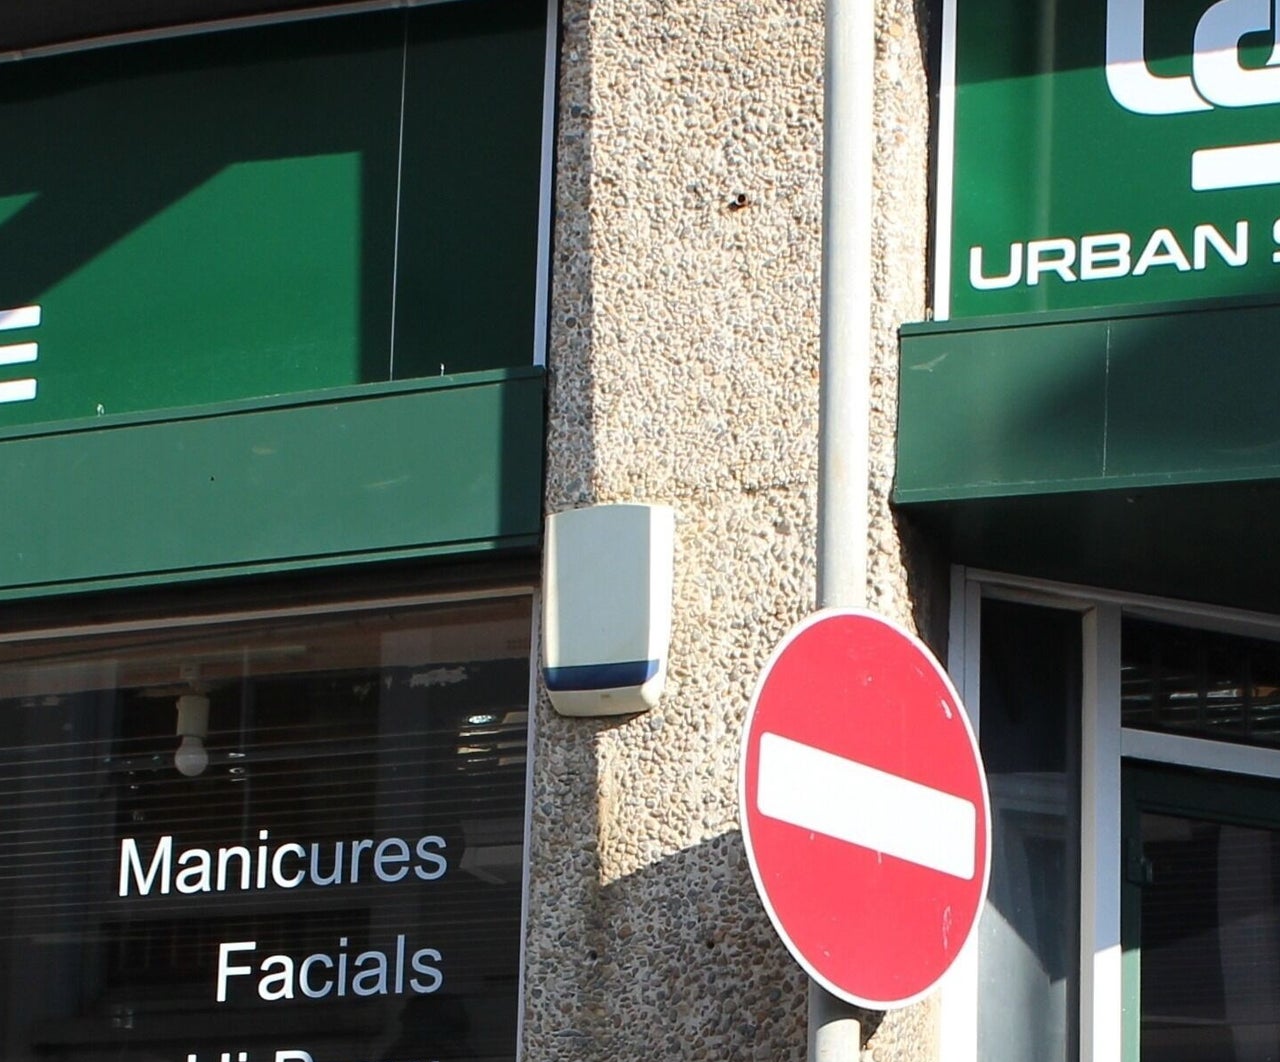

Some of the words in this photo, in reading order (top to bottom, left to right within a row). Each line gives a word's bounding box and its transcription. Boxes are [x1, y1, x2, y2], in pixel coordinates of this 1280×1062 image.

[969, 220, 1249, 290] URBAN
[118, 830, 448, 896] Manicures
[216, 934, 444, 1002] Facials
